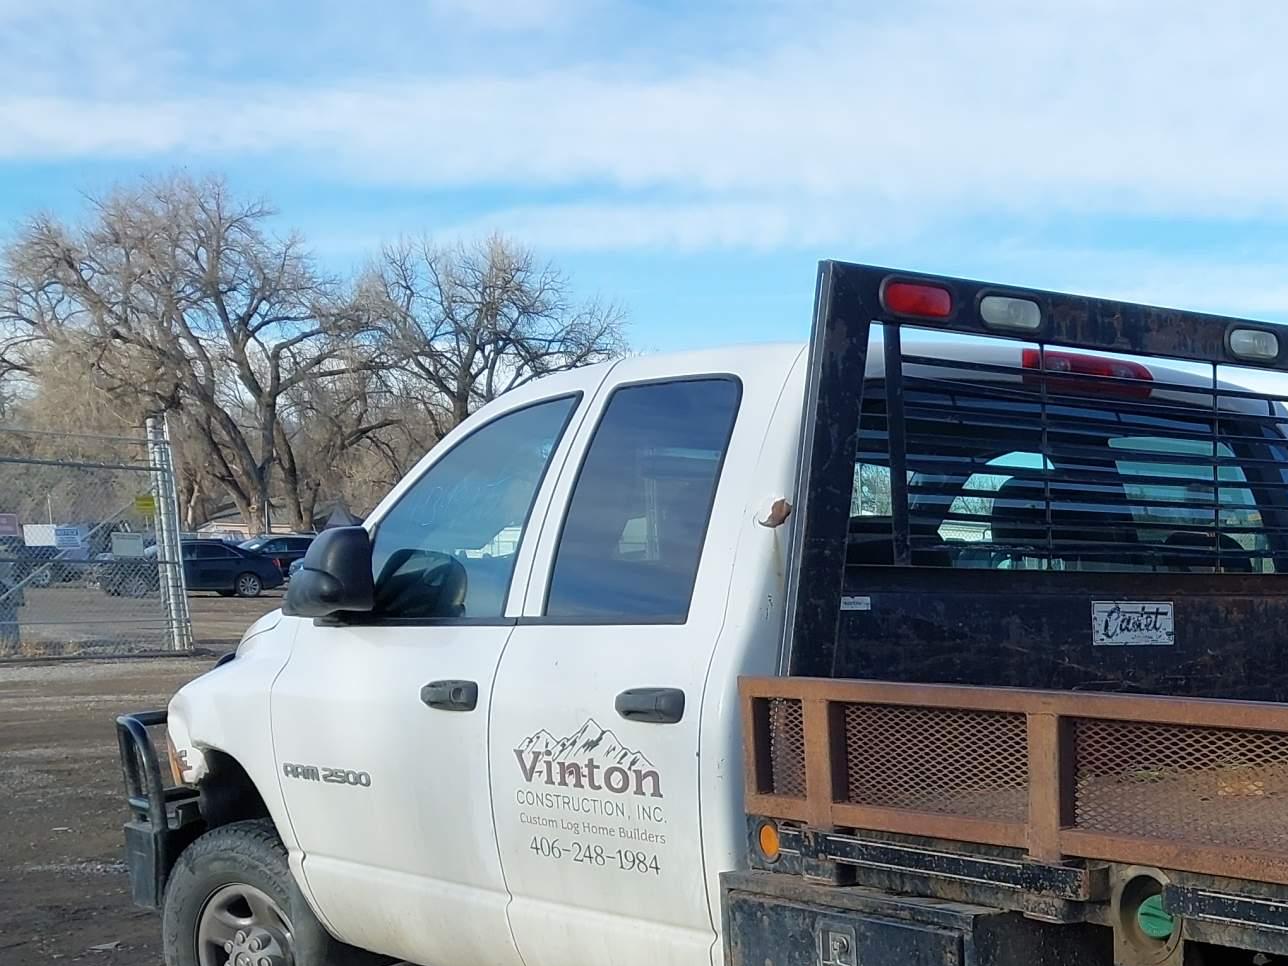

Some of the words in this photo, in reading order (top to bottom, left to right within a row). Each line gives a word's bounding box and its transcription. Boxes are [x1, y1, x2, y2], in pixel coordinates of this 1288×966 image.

[282, 762, 321, 782] RAM
[321, 767, 371, 787] 2500
[513, 748, 664, 798] Vinton
[516, 789, 632, 821] CONSTRUCTION,
[637, 804, 668, 824] INC.
[519, 812, 558, 829] Custom
[561, 819, 580, 835] Log
[582, 822, 616, 837] Home
[619, 827, 666, 844] Builders
[530, 836, 661, 875] 406-248-1984
